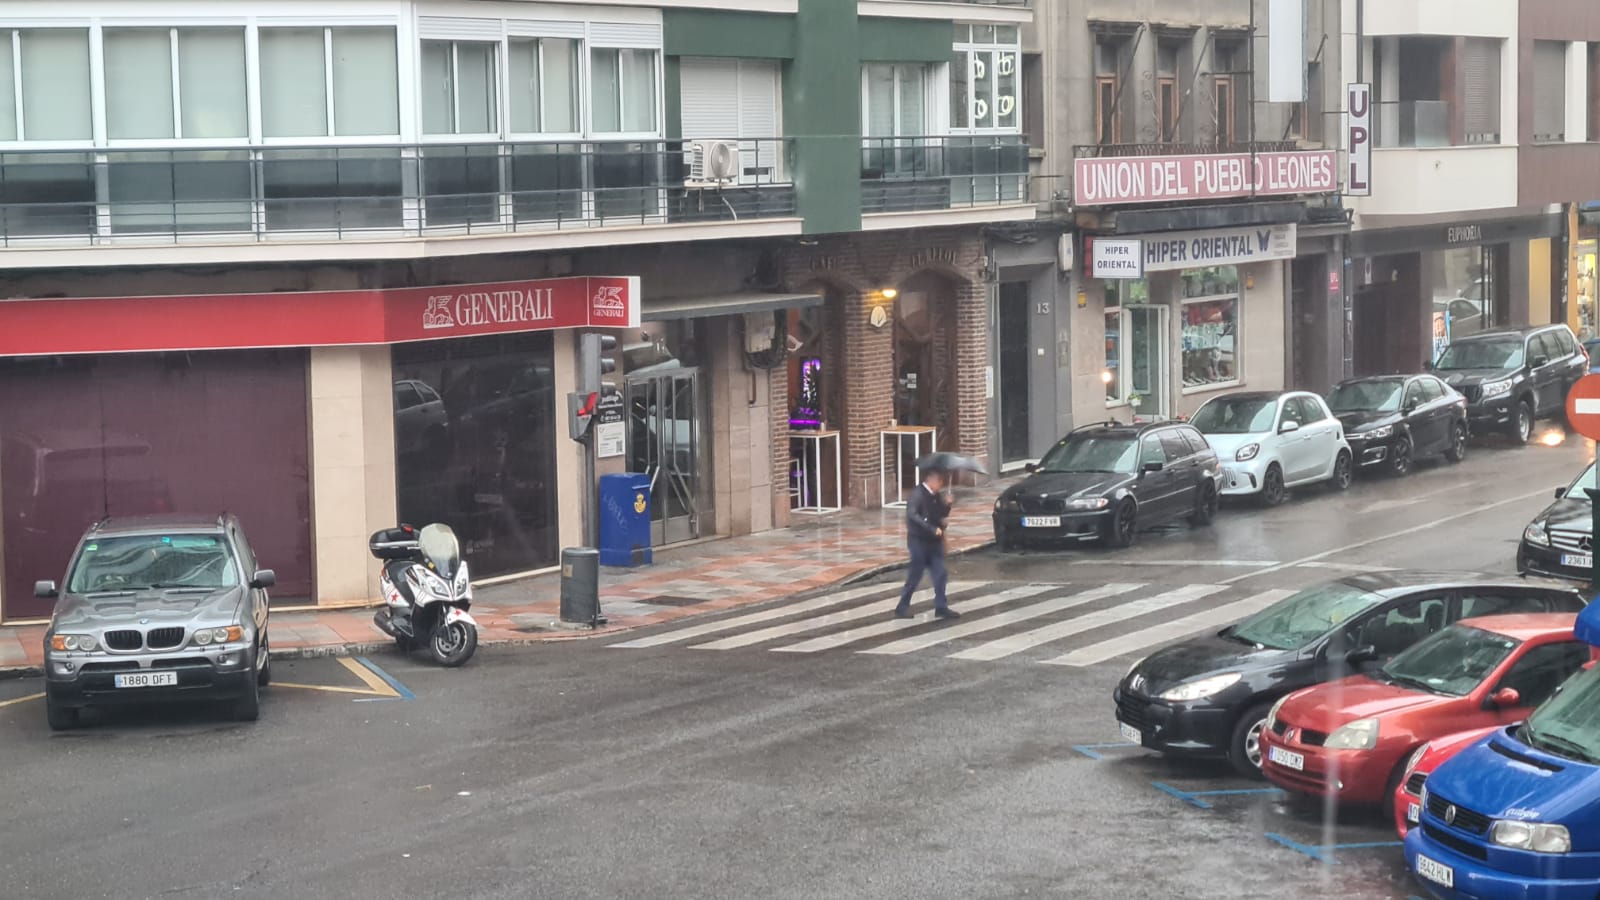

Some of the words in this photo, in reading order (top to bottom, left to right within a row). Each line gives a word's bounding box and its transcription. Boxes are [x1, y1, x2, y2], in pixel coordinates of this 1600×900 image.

[1350, 91, 1368, 189] UPL
[1083, 162, 1145, 199] UNION
[1152, 160, 1188, 196] DEL
[1194, 157, 1264, 194] PUEBLO
[1268, 155, 1331, 189] LEONES
[1105, 246, 1129, 254] HIPER
[1146, 240, 1186, 263] HIPER
[1191, 235, 1253, 259] ORIENTAL
[1097, 260, 1136, 269] ORIENTAL
[455, 288, 554, 326] GENERALI
[593, 308, 625, 317] GENERALI
[1037, 302, 1049, 314] 13
[123, 675, 148, 686] 1880
[152, 674, 172, 685] DFT
